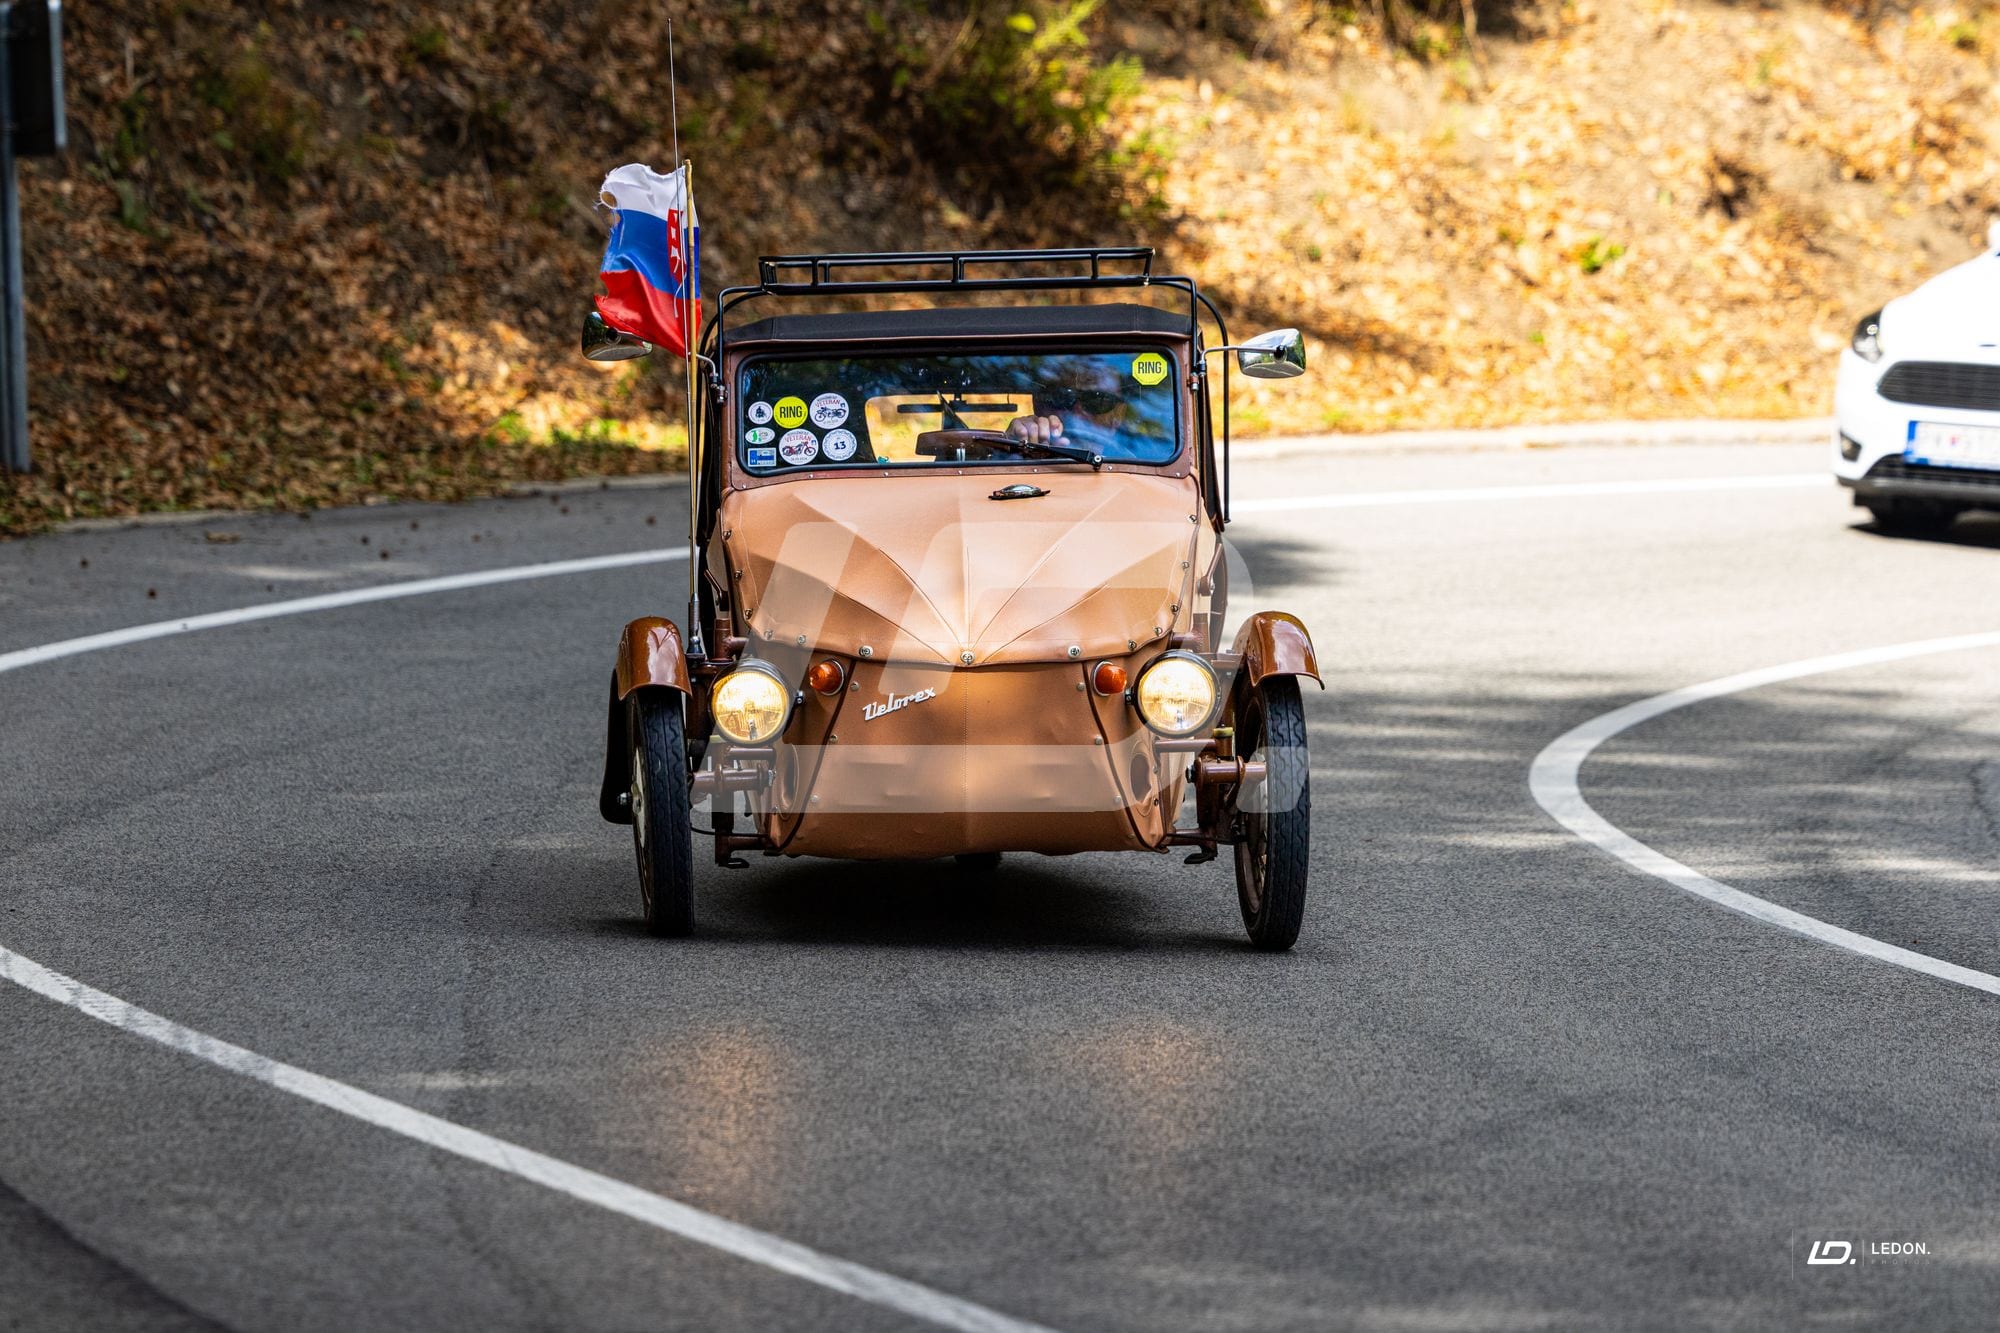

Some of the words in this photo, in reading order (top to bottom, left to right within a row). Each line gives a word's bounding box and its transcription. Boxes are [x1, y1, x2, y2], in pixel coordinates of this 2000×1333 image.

[1137, 361, 1162, 374] RING
[779, 406, 803, 418] RING
[784, 434, 812, 442] VETERAN
[833, 441, 847, 450] 13
[862, 687, 936, 720] Velorex
